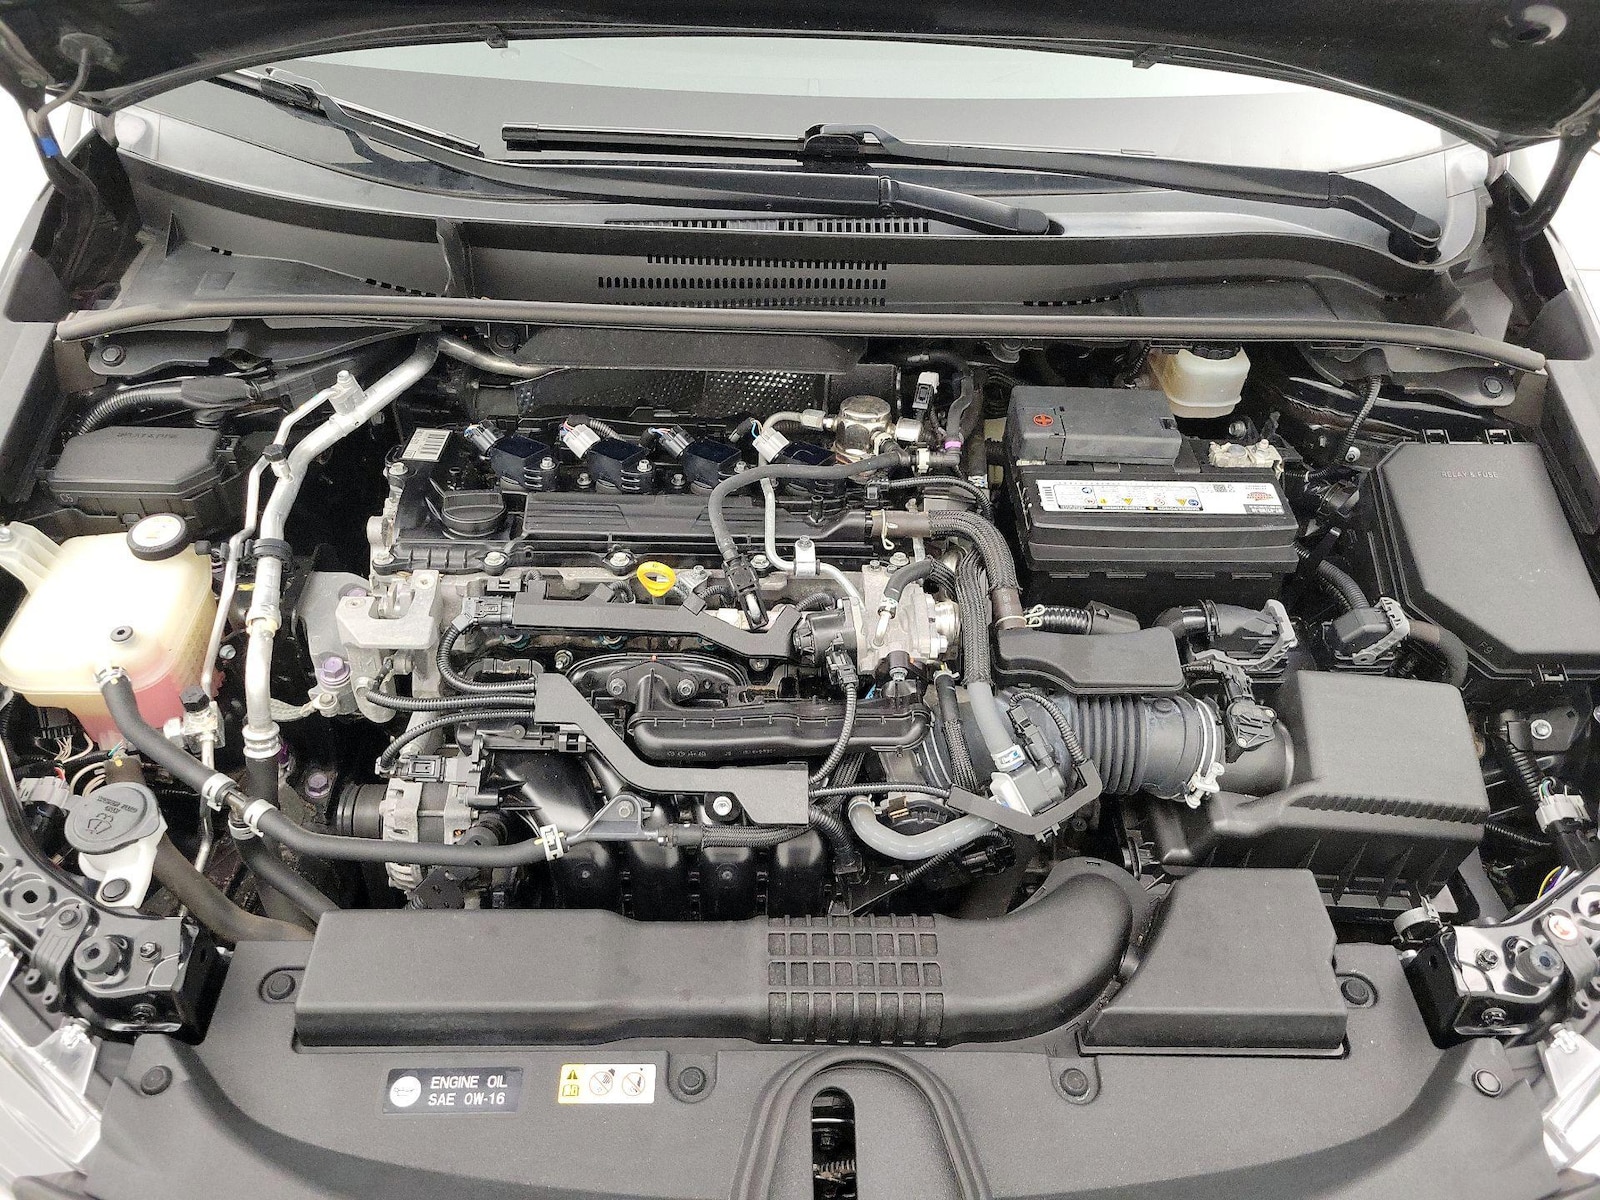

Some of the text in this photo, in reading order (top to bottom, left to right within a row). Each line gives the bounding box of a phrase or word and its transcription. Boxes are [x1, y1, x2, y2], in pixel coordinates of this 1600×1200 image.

[430, 1075, 508, 1089] ENGINE OIL
[428, 1092, 506, 1106] SAE 0W-16
